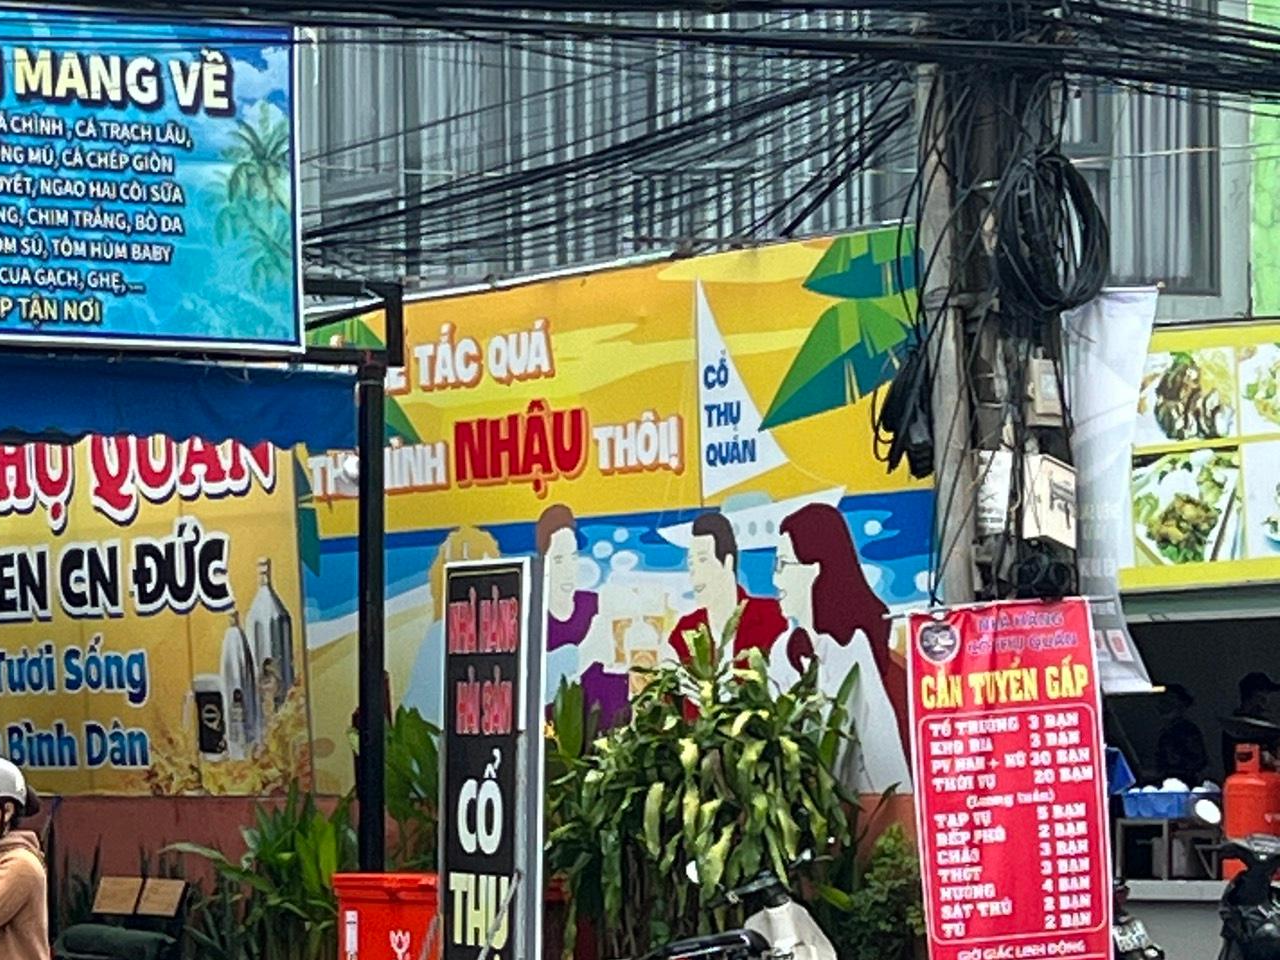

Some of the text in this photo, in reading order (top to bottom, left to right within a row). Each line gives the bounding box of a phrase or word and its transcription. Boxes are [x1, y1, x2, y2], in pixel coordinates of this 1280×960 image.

[14, 50, 158, 102] MANG
[171, 47, 230, 110] VỀ
[75, 116, 97, 138] CÁ
[62, 145, 84, 167] CÁ
[40, 178, 85, 198] NGAO
[88, 181, 117, 200] HAI
[27, 206, 68, 226] CHIM
[160, 214, 184, 233] DA
[51, 235, 87, 258] TÔM
[131, 244, 172, 262] BABY
[18, 291, 58, 325] TẬN
[63, 297, 101, 322] NƠI
[414, 320, 482, 388] TÁC
[487, 316, 553, 382] QUÁ
[453, 398, 588, 498] NHẬU
[594, 408, 686, 475] THÔI!
[58, 543, 122, 620] CN
[132, 518, 231, 614] ĐỨC
[64, 636, 150, 704] Sống
[921, 654, 1090, 710] CẦN TUYỂN GẤP
[11, 722, 78, 767] Bình
[86, 722, 150, 768] Dân
[987, 757, 1000, 769] +
[458, 749, 503, 855] CỔ
